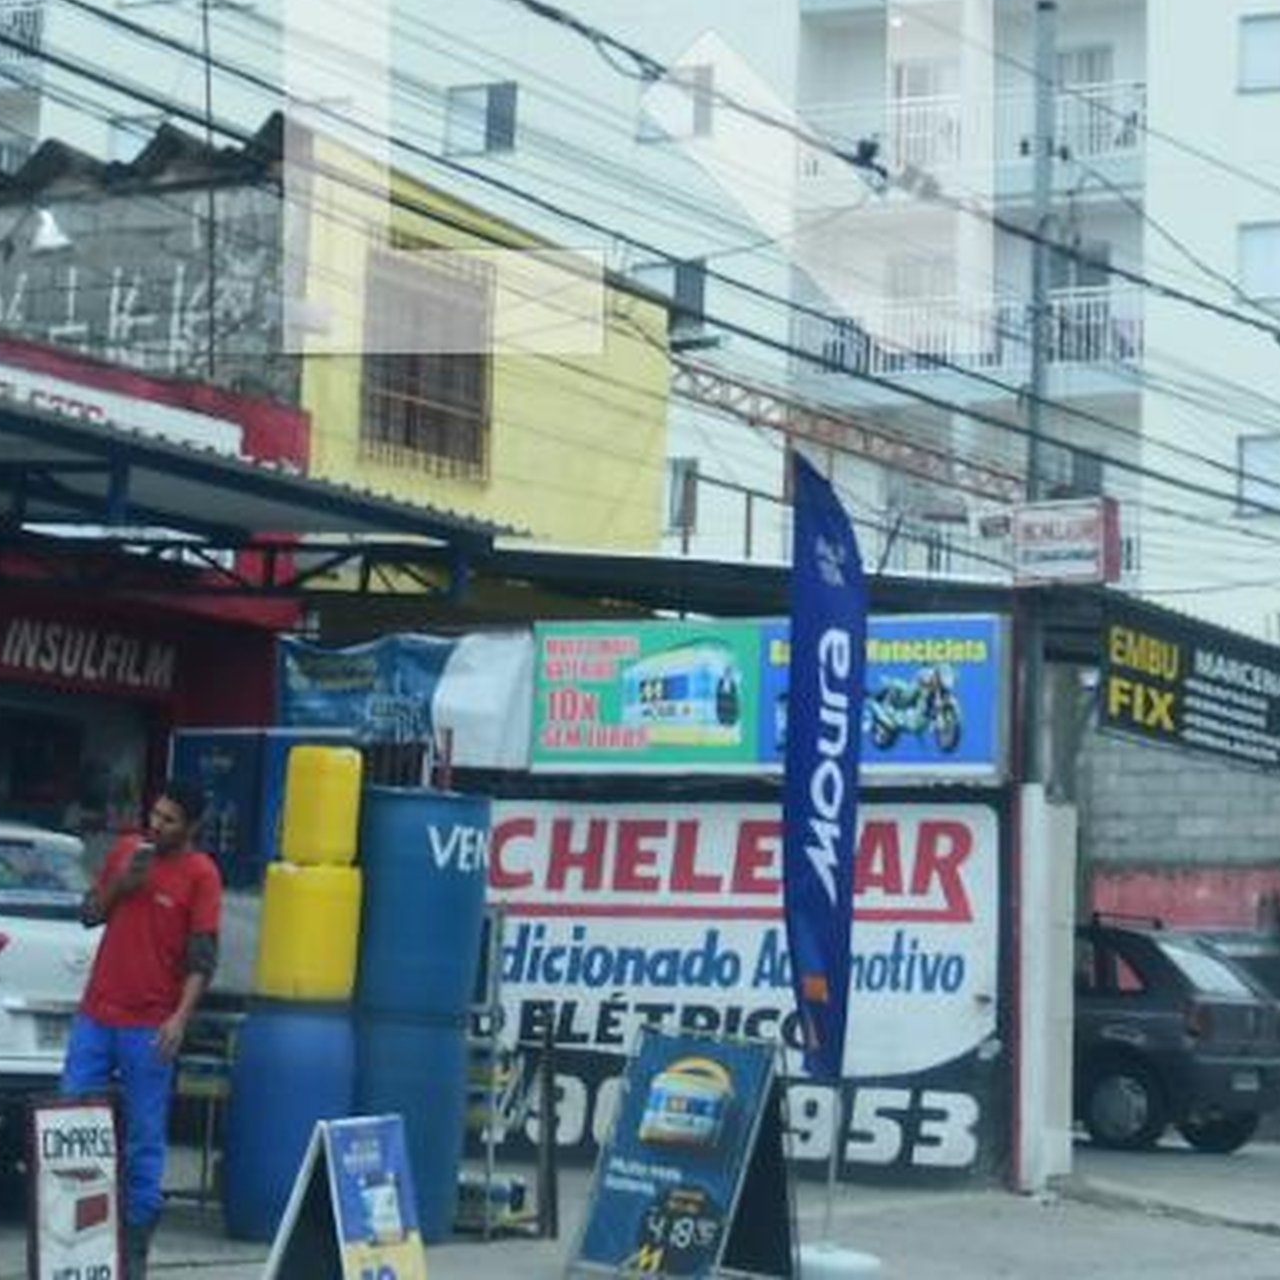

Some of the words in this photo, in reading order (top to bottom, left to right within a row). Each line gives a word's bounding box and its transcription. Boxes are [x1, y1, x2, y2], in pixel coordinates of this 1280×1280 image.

[1, 619, 178, 689] INSULFILM
[1109, 625, 1179, 680] EMBU
[1108, 676, 1175, 731] FIX
[488, 816, 974, 908] CHELEAR
